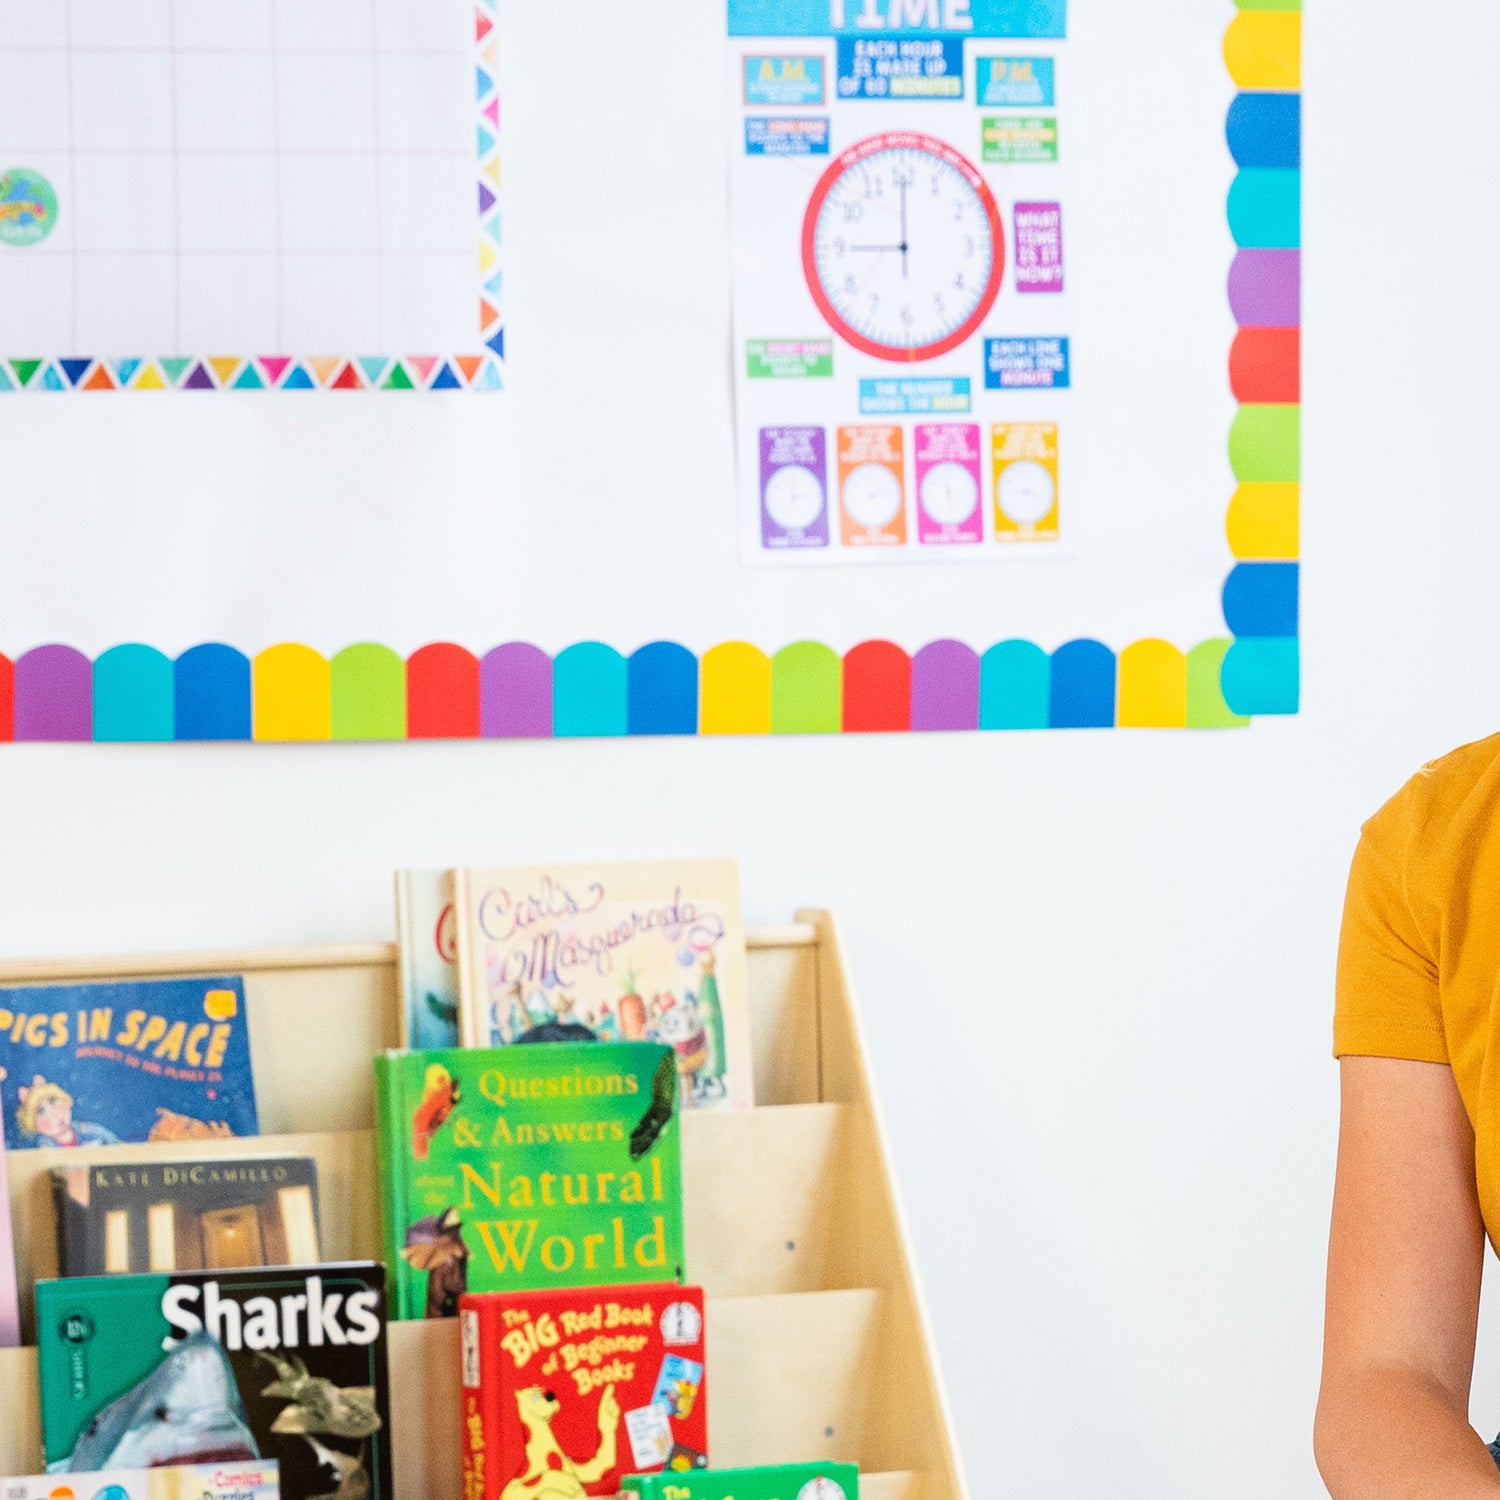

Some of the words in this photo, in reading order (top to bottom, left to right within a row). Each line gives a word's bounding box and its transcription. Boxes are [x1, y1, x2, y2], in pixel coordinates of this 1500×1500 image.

[77, 1007, 113, 1043] IN
[116, 1009, 232, 1068] SPACE
[478, 1068, 639, 1107] Questions
[453, 1117, 482, 1148] &
[490, 1116, 624, 1147] Answers
[459, 1157, 663, 1209] Natural
[475, 1215, 668, 1274] World
[161, 1276, 380, 1352] Sharks
[500, 1312, 560, 1369] BIG
[559, 1303, 603, 1336] Red
[604, 1302, 654, 1328] Book
[501, 1308, 530, 1328] The
[541, 1351, 559, 1376] of
[559, 1334, 649, 1372] Beginner
[571, 1357, 636, 1396] Books
